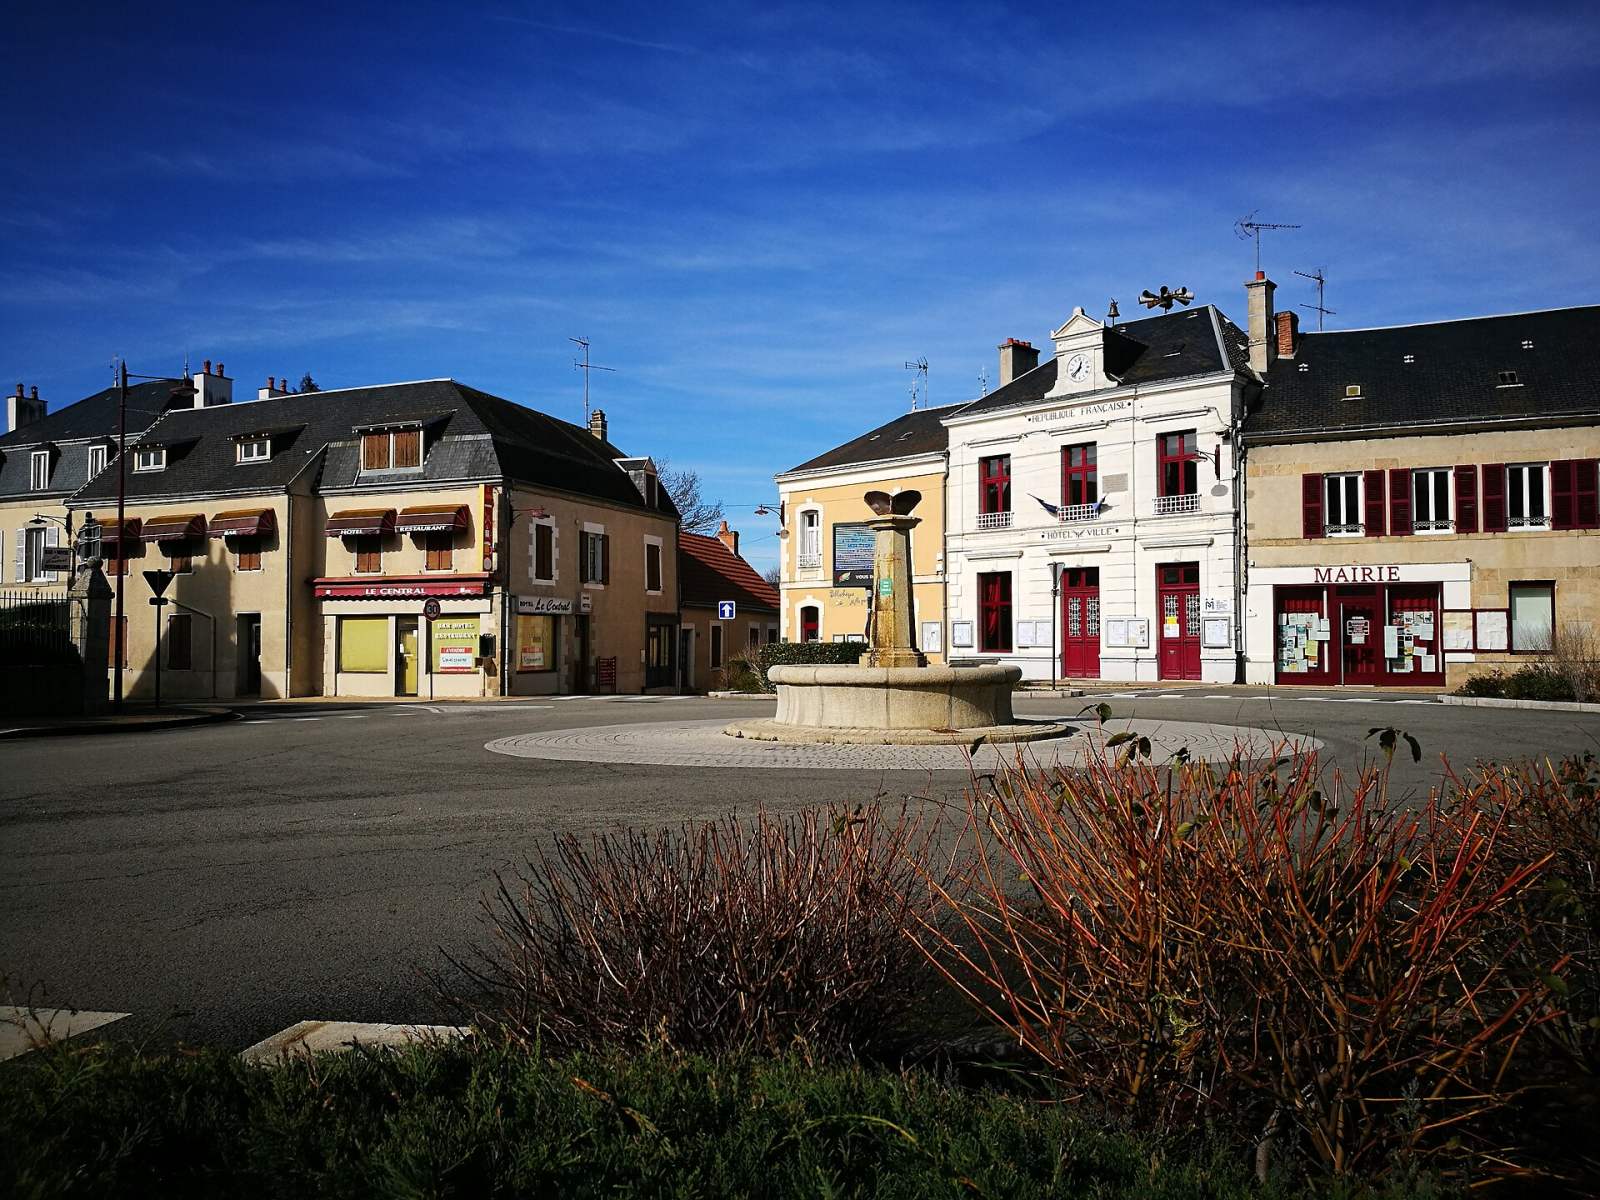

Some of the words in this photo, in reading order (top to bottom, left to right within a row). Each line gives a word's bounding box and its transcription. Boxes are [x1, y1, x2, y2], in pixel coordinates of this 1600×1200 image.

[1086, 527, 1114, 536] VILLE
[1314, 566, 1401, 583] MAIRIE
[380, 587, 427, 595] CENTRAL
[426, 604, 438, 615] 30
[534, 598, 545, 611] Le
[546, 599, 571, 611] Central
